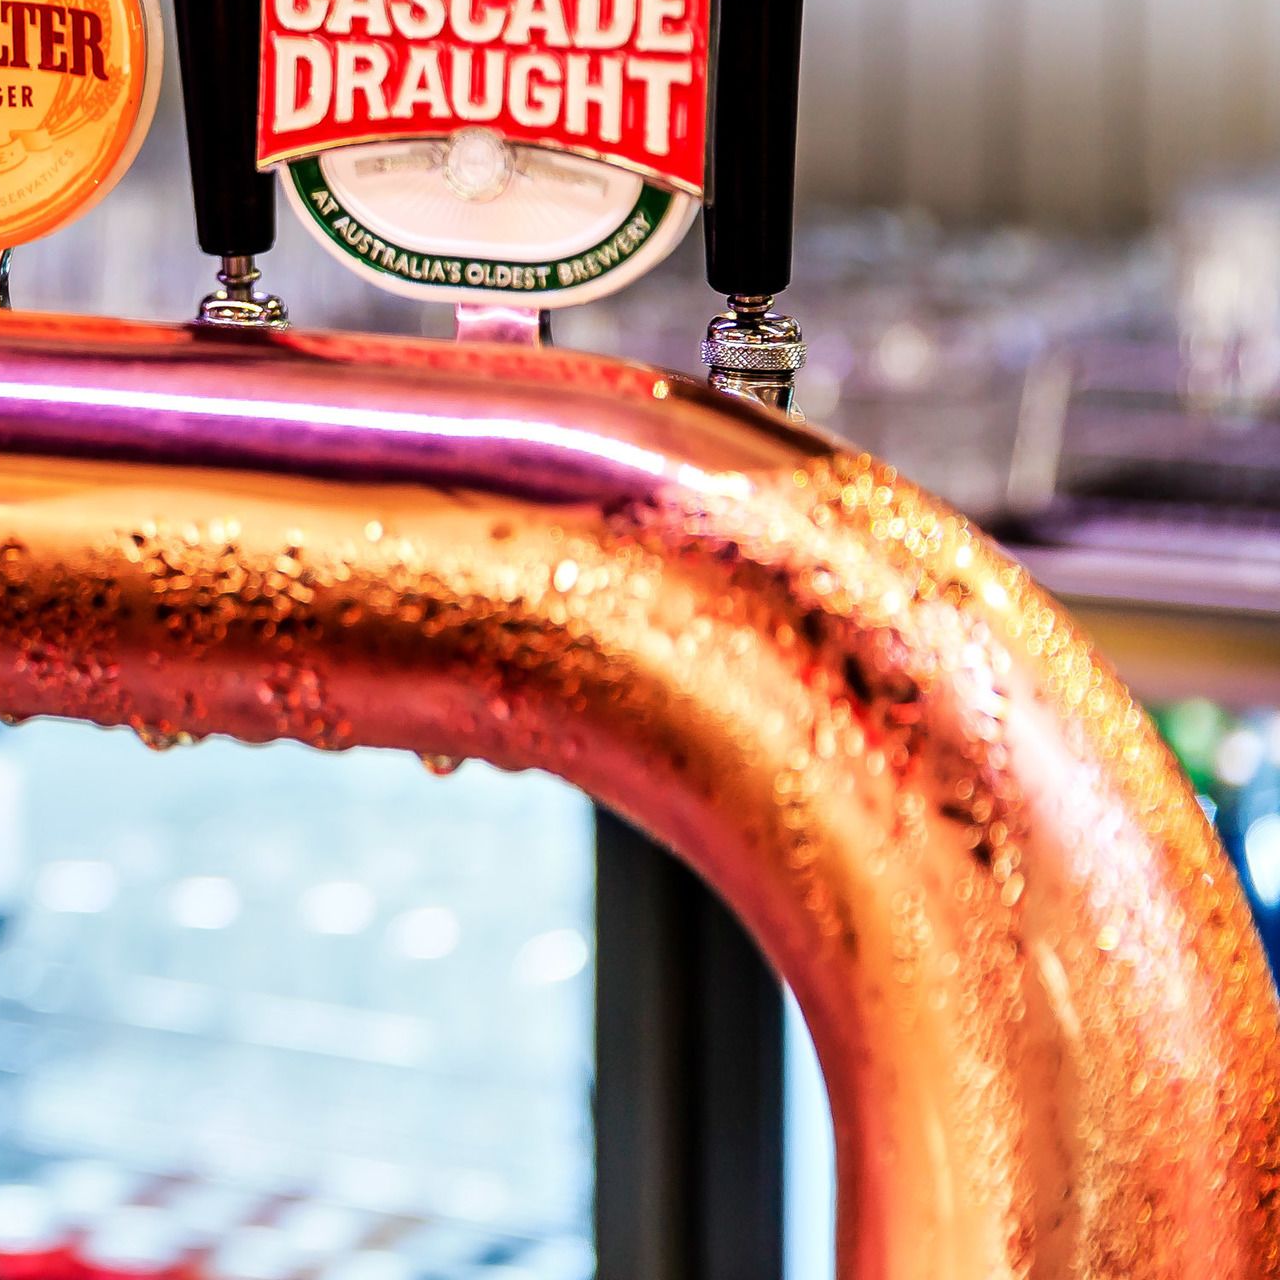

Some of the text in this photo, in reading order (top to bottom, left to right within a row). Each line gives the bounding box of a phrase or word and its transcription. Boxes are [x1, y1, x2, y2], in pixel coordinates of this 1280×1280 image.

[273, 34, 694, 156] DRAUGHT
[310, 189, 652, 291] AT AUSTRALIA'S OLDEST BREWERY
